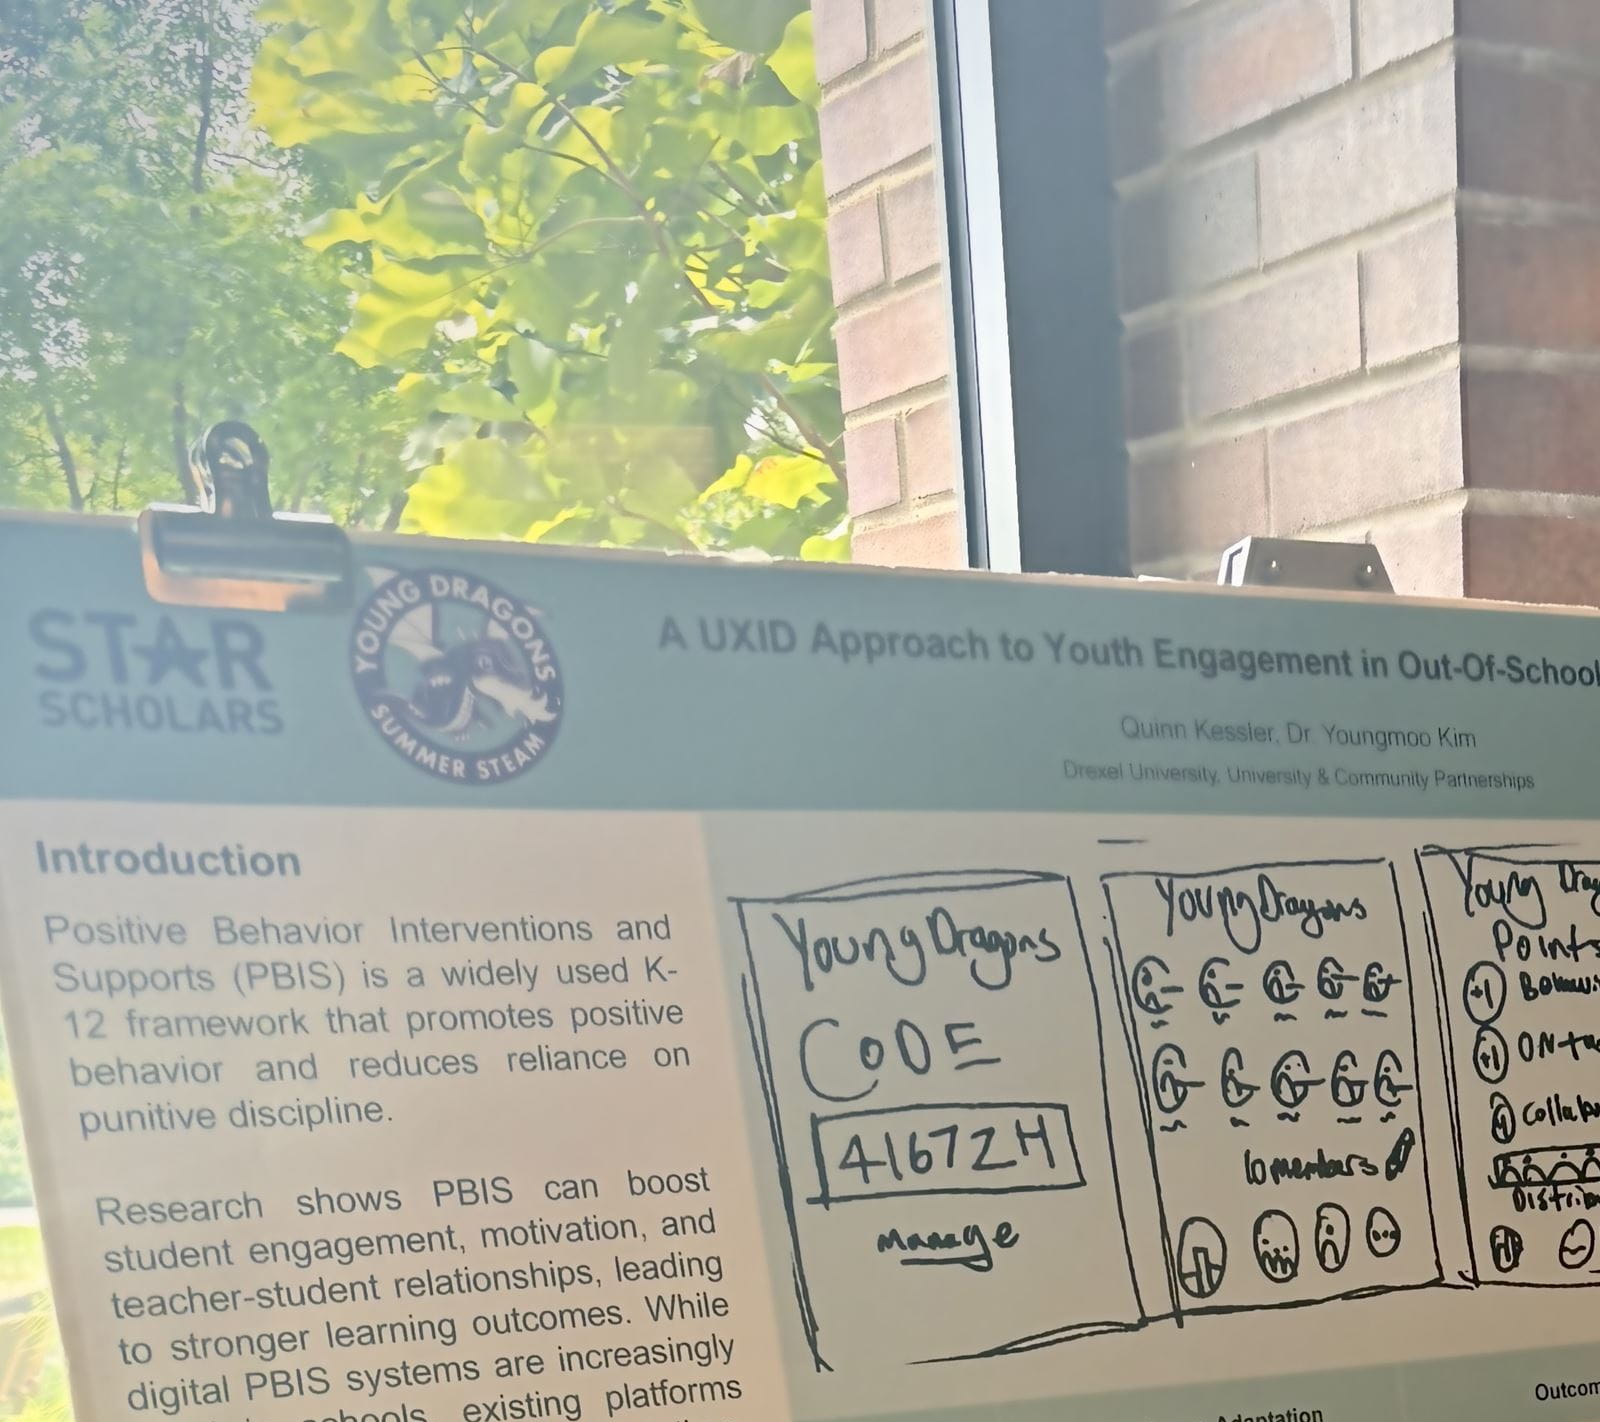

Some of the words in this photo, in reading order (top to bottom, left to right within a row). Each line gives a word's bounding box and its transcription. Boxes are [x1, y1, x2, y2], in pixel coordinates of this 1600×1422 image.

[355, 578, 421, 673] YOUNG
[430, 574, 556, 681] DRAGONS
[661, 618, 685, 648] A
[700, 620, 795, 652] UXID
[812, 623, 988, 663] Approach
[1000, 634, 1034, 661] to
[1045, 634, 1143, 666] Youth
[1154, 638, 1352, 680] Engagement
[1362, 649, 1388, 677] in
[40, 690, 284, 735] SCHOLARS
[371, 703, 465, 778] SUMMER
[476, 732, 545, 779] STEAM
[1121, 716, 1187, 739] Quinn
[1322, 724, 1431, 752] Youngmoo
[1438, 727, 1476, 748] Kim
[1064, 760, 1123, 780] Drexel
[1227, 767, 1311, 789] University
[1317, 768, 1330, 785] &
[1334, 768, 1428, 791] Community
[1434, 769, 1535, 792] Partnerships
[36, 840, 301, 877] Introduction
[44, 916, 186, 944] Positive
[213, 916, 362, 945] Behavior
[390, 915, 593, 943] Interventions
[617, 914, 671, 941] and
